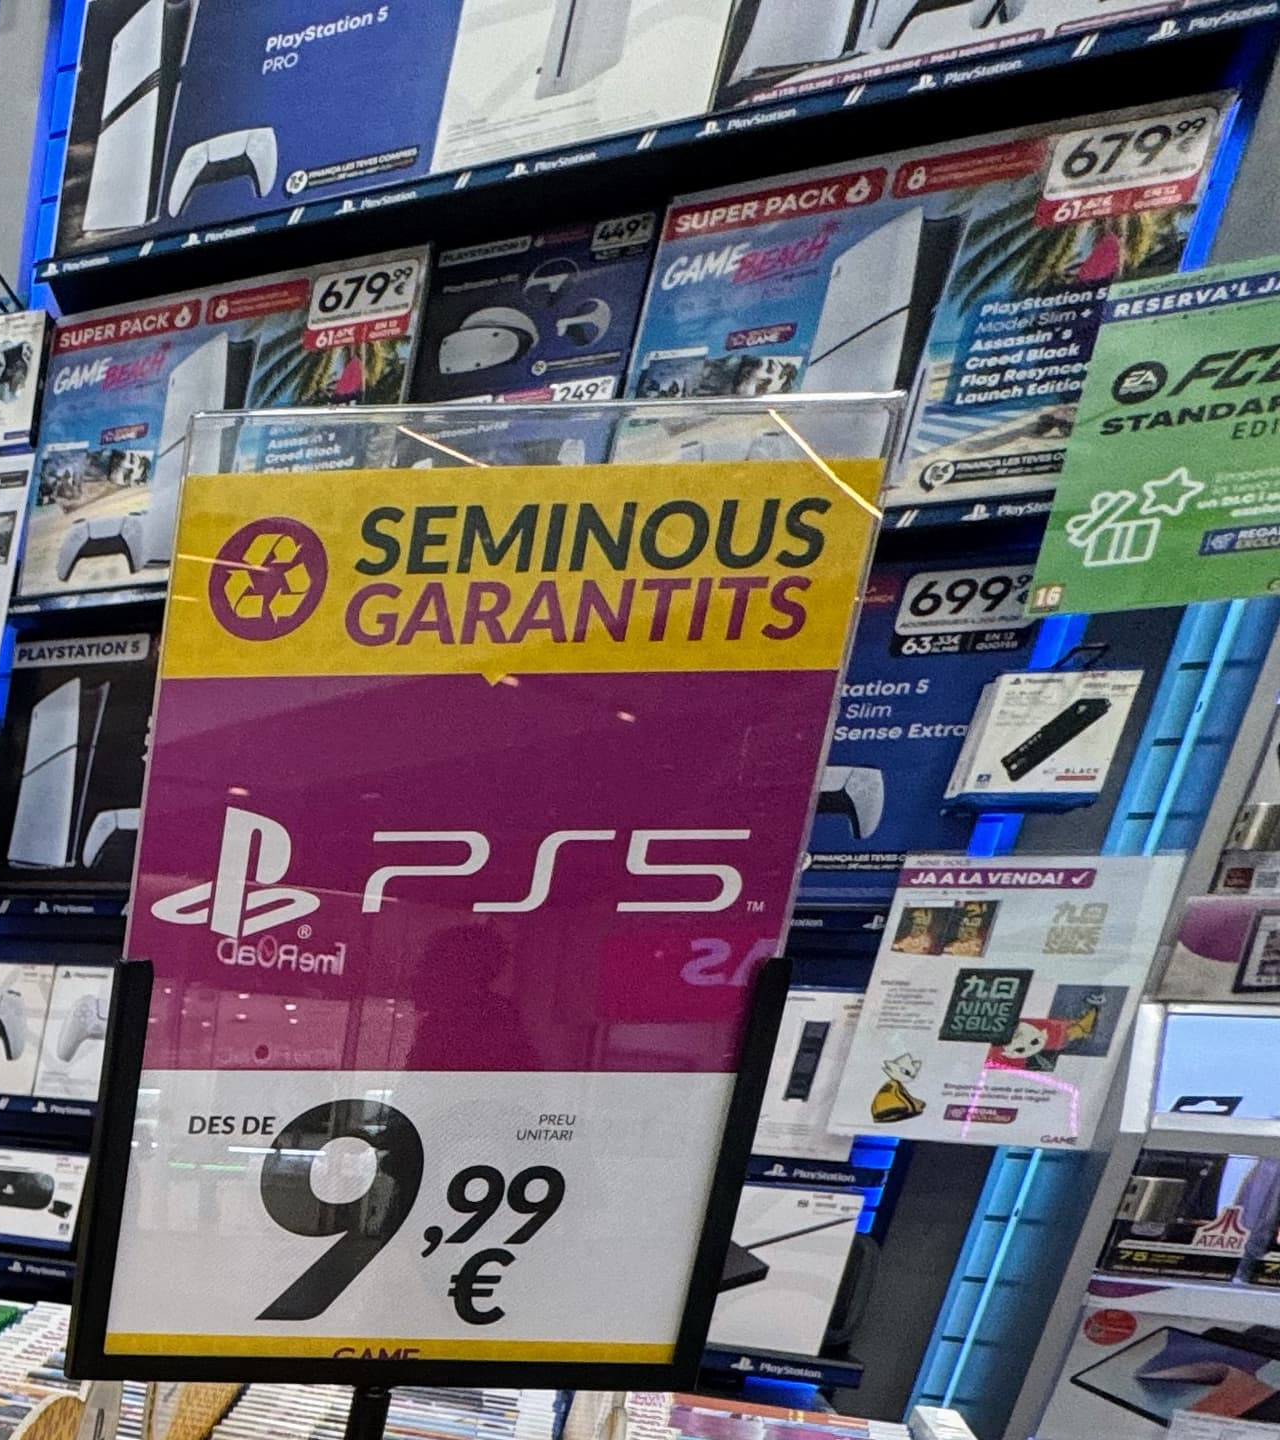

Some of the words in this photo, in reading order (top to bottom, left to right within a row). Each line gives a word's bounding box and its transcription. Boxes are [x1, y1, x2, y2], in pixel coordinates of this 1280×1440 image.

[266, 12, 373, 52] PlayStation
[377, 6, 388, 22] 5
[1188, 5, 1278, 33] PlayStation
[262, 53, 298, 74] PRO
[944, 59, 1023, 86] PlayStation
[674, 202, 760, 233] SUPER
[764, 186, 837, 219] PACK
[661, 242, 751, 290] GAME
[981, 291, 1093, 317] PlayStation
[1114, 282, 1249, 318] RESERVA'L
[60, 324, 115, 348] SUPER
[119, 315, 168, 338] PACK
[975, 315, 1032, 333] Model
[1036, 310, 1077, 326] Slim
[965, 351, 1023, 370] Creed
[1026, 343, 1081, 361] Black
[54, 358, 111, 394] GAME
[959, 369, 1000, 390] Flag
[954, 386, 1023, 405] Launch
[352, 496, 833, 577] SEMINOUS
[344, 574, 814, 647] GARANTITS
[17, 643, 129, 662] PLAYSTATION
[846, 702, 892, 719] Slim
[907, 723, 969, 739] Extra
[360, 828, 753, 915] PS5
[910, 872, 938, 885] JA
[958, 872, 985, 884] LA
[988, 871, 1064, 885] VENDA!
[954, 1001, 1014, 1017] NINE
[188, 1114, 234, 1138] DES
[241, 1114, 275, 1138] DE
[538, 1112, 578, 1128] PREU
[515, 1127, 576, 1143] UNITARI
[793, 1166, 856, 1183] PlayStation
[255, 1099, 567, 1322] 9,99
[1195, 1235, 1246, 1248] ATARI
[448, 1248, 517, 1326] €
